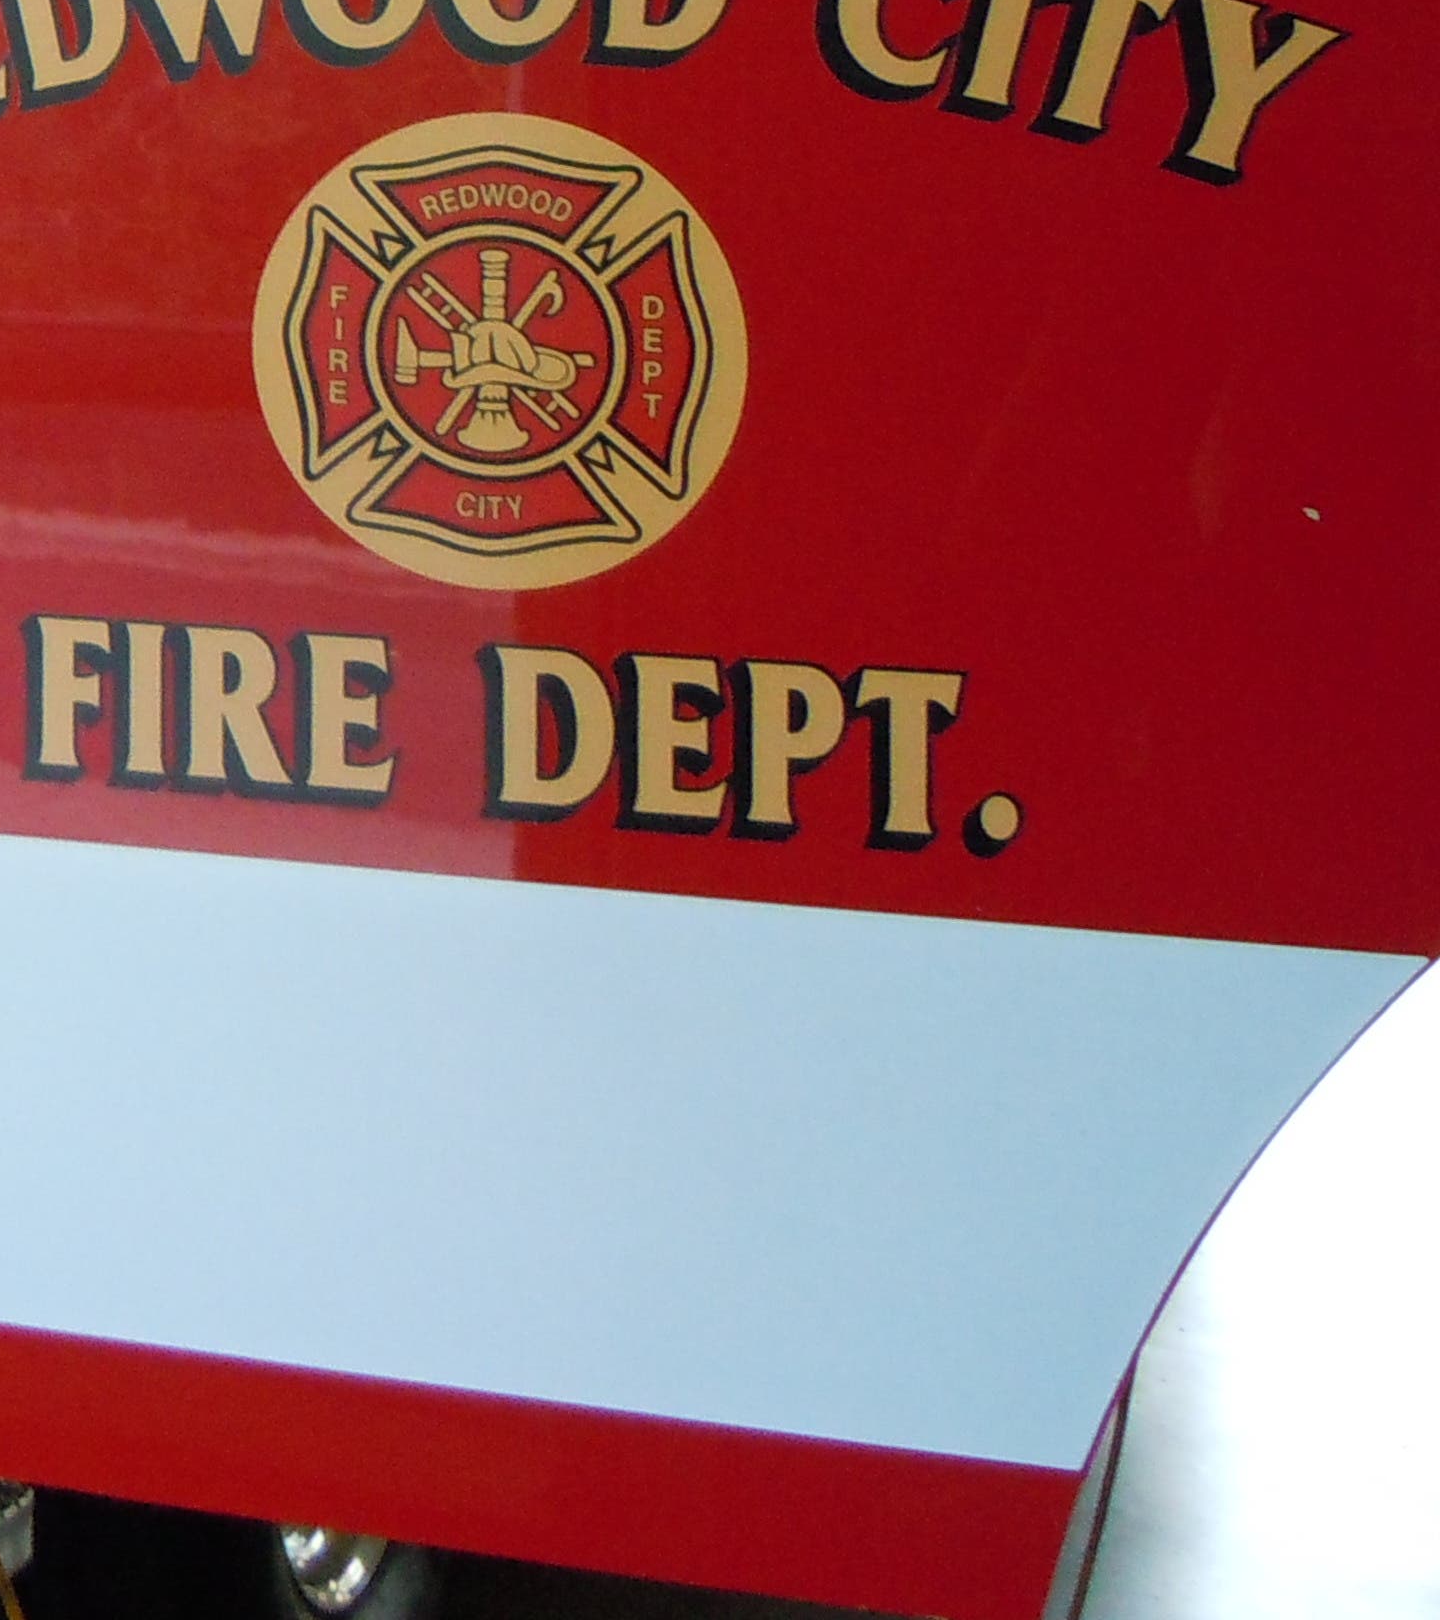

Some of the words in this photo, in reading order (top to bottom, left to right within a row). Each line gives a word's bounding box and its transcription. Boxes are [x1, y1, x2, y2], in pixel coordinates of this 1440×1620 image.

[419, 183, 575, 224] REDWOOD
[327, 284, 350, 406] FIRE
[640, 295, 666, 419] DEPT
[455, 491, 523, 520] CITY
[22, 615, 396, 806] FIRE
[480, 644, 1023, 859] DEPT.
